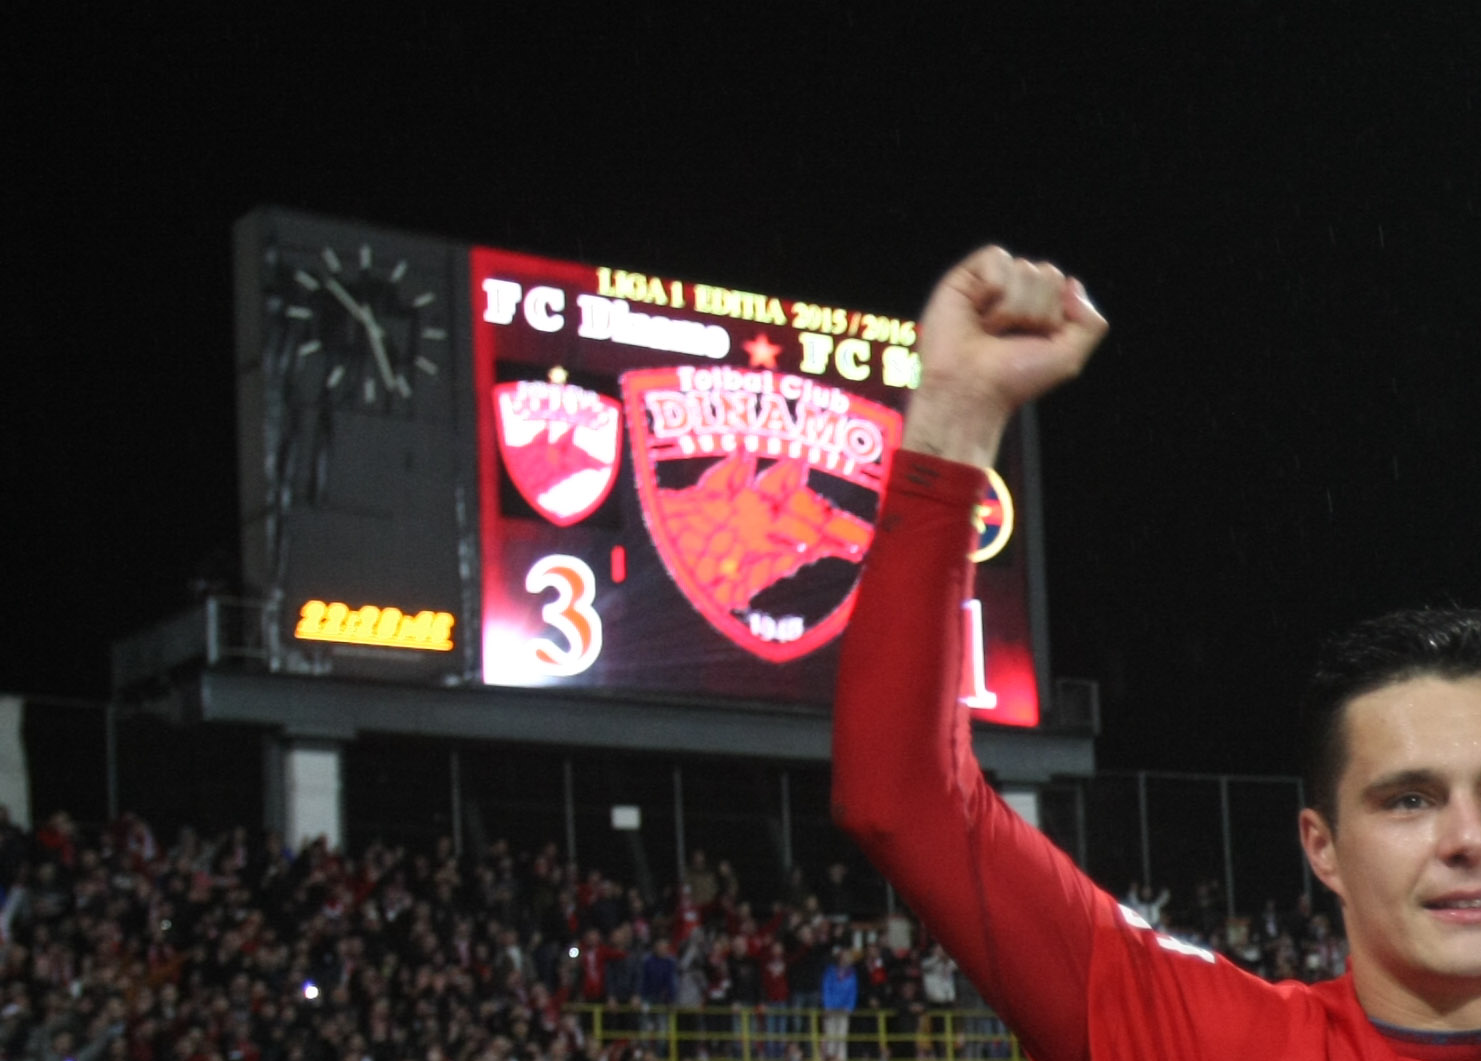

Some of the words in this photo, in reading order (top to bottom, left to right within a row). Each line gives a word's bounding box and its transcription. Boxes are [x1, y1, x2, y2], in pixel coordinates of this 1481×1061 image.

[482, 278, 565, 332] FC
[596, 266, 667, 306] LIGA
[799, 332, 872, 381] FC
[645, 388, 884, 465] DINAMO
[523, 554, 603, 677] 3
[958, 598, 998, 709] 1
